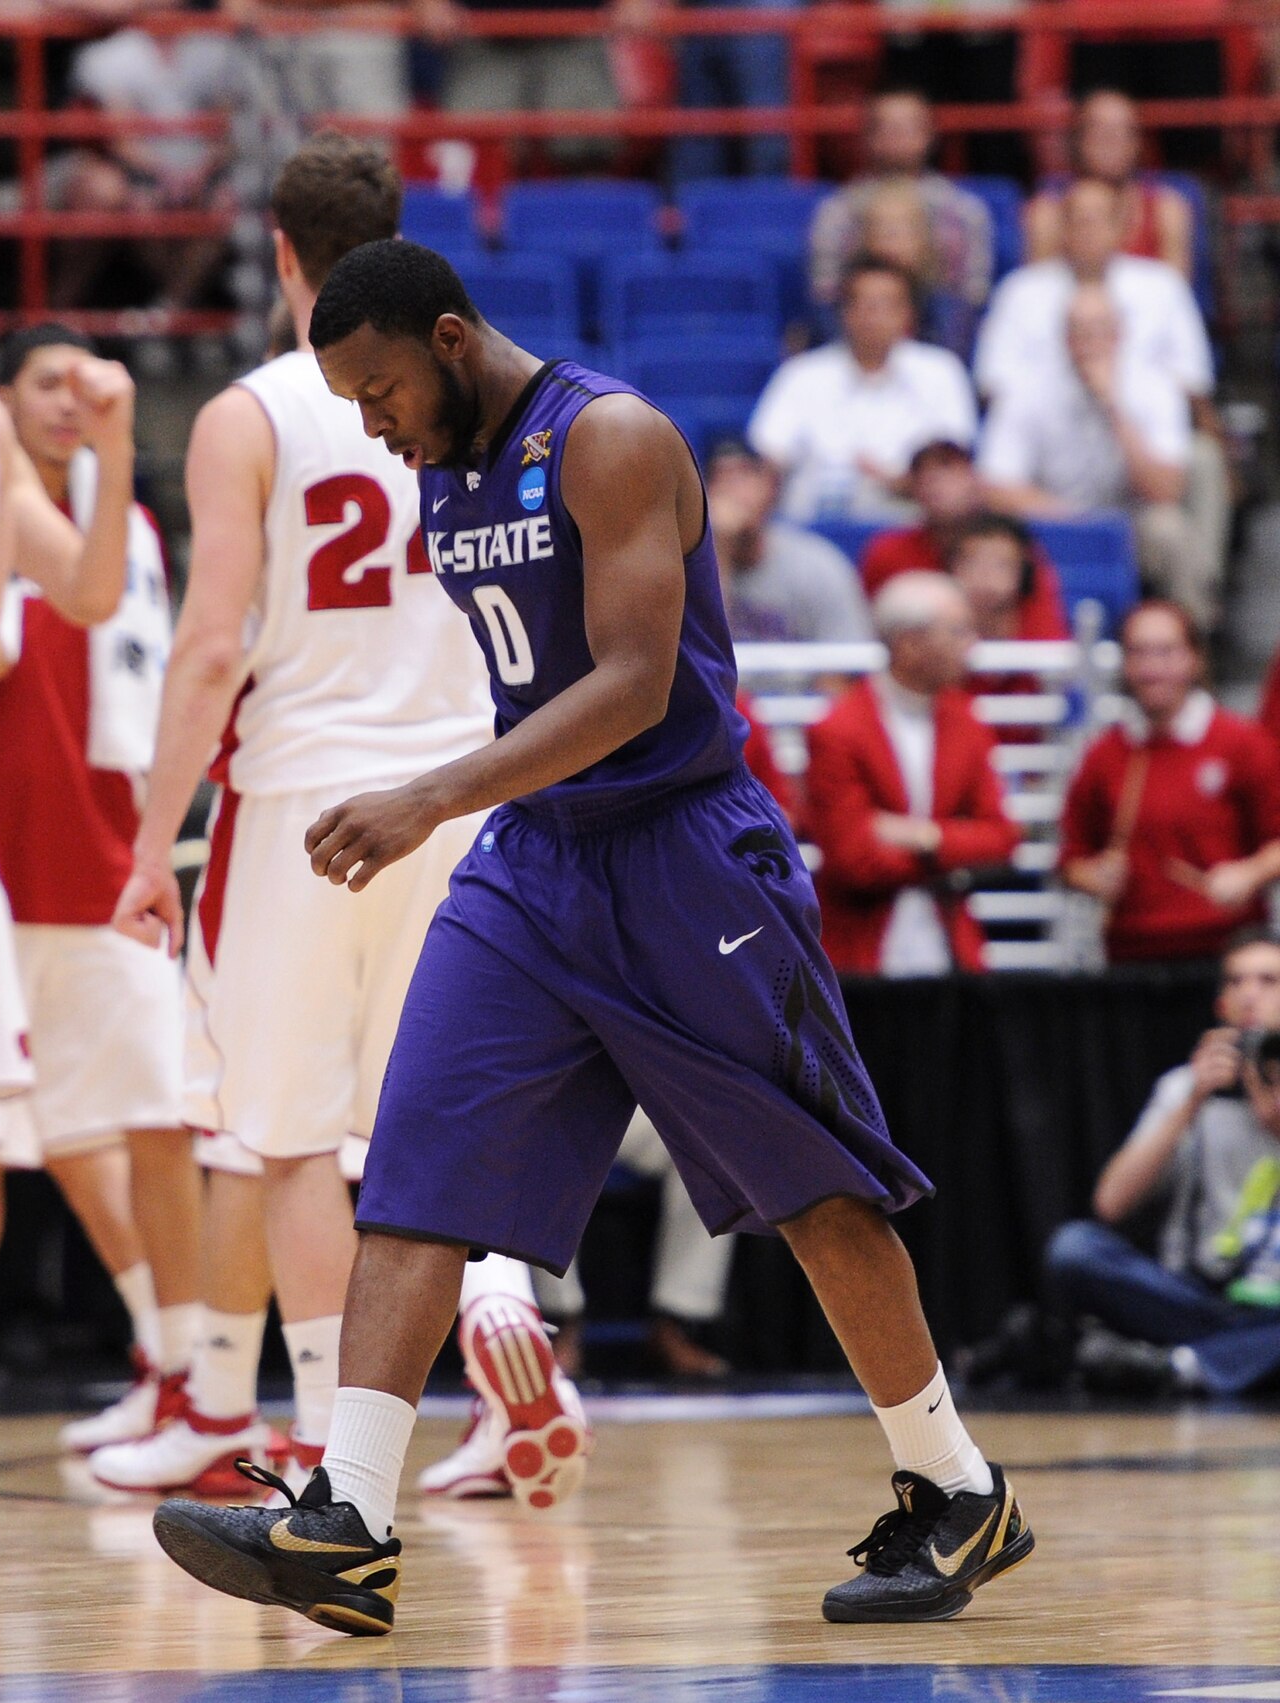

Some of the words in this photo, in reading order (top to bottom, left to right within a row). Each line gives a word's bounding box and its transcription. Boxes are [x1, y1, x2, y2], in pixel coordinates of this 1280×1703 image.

[522, 486, 545, 501] NCAA
[304, 474, 433, 611] 2
[427, 514, 555, 575] K-STATE
[472, 584, 536, 687] 0
